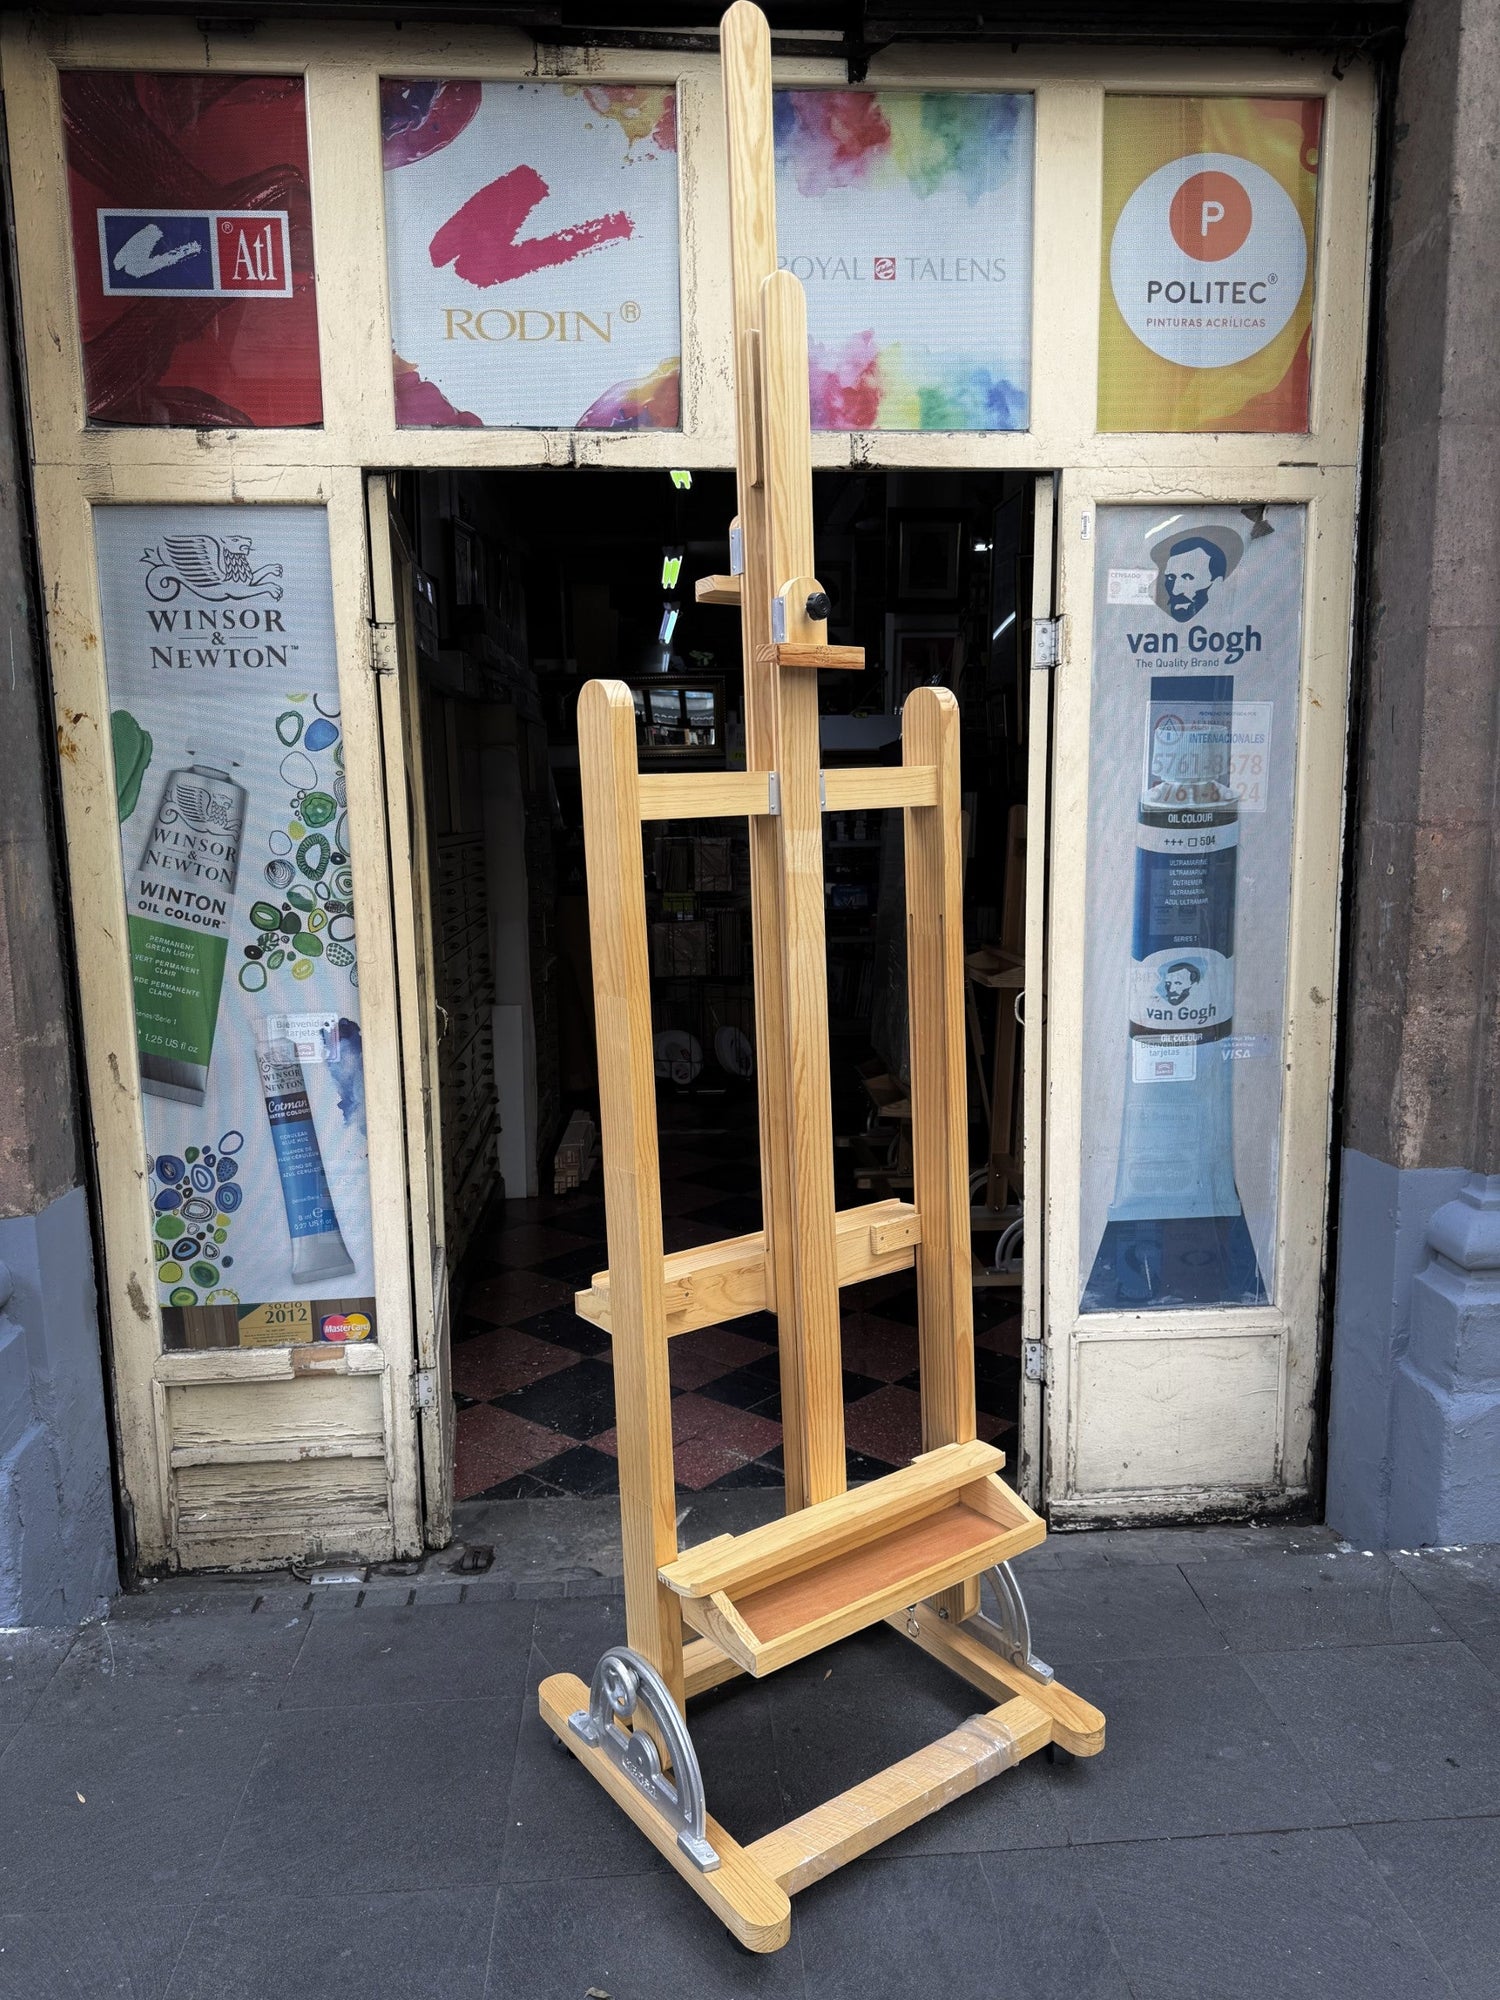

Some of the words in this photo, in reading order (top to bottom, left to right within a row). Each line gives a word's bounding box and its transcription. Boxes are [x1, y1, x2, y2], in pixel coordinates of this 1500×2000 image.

[1201, 201, 1225, 236] P
[232, 224, 278, 281] Atl
[905, 257, 1007, 282] TALENS
[1148, 280, 1267, 304] POLITEC
[441, 308, 613, 343] RODIN
[1146, 317, 1202, 328] PINTURAS
[1206, 315, 1266, 328] ACRÍLICAS
[146, 609, 286, 633] WINSOR
[211, 632, 226, 646] &
[1127, 632, 1178, 654] van
[1188, 625, 1262, 665] Gogh
[150, 645, 288, 669] NEWTON
[1136, 659, 1152, 668] The
[1156, 658, 1188, 670] Quality
[1191, 658, 1219, 667] Brand
[1189, 733, 1265, 744] INTERNACIONALES
[1168, 814, 1181, 823] OIL
[1182, 813, 1213, 823] COLOUR
[153, 828, 236, 863] WINSOR
[1200, 835, 1216, 846] 504
[187, 851, 198, 861] &
[146, 850, 234, 885] NEWTON
[140, 880, 226, 915] WINTON
[138, 901, 159, 914] OIL
[164, 907, 221, 929] COLOUR
[145, 942, 171, 955] GREEN
[173, 949, 195, 960] LIGHT
[134, 953, 153, 964] VERT
[155, 959, 200, 976] PERMANENT
[154, 966, 177, 977] CLAIR
[148, 987, 173, 999] CLARO
[151, 980, 200, 998] PERMANENTE
[1147, 1007, 1172, 1021] van
[1178, 1003, 1216, 1024] Gogh
[145, 1033, 163, 1045] 1.25
[165, 1036, 178, 1049] US
[188, 1045, 198, 1053] oz
[1161, 1034, 1172, 1042] OIL
[1173, 1033, 1203, 1042] COLOUR
[1149, 1048, 1180, 1057] tarjetas
[1222, 1049, 1251, 1061] VISA
[263, 1069, 301, 1081] WINSOR
[265, 1079, 304, 1092] NEWTON
[268, 1099, 307, 1113] Cotman
[268, 1301, 302, 1310] SOCIO
[265, 1309, 308, 1324] 2012
[325, 1322, 369, 1333] MasterCard
